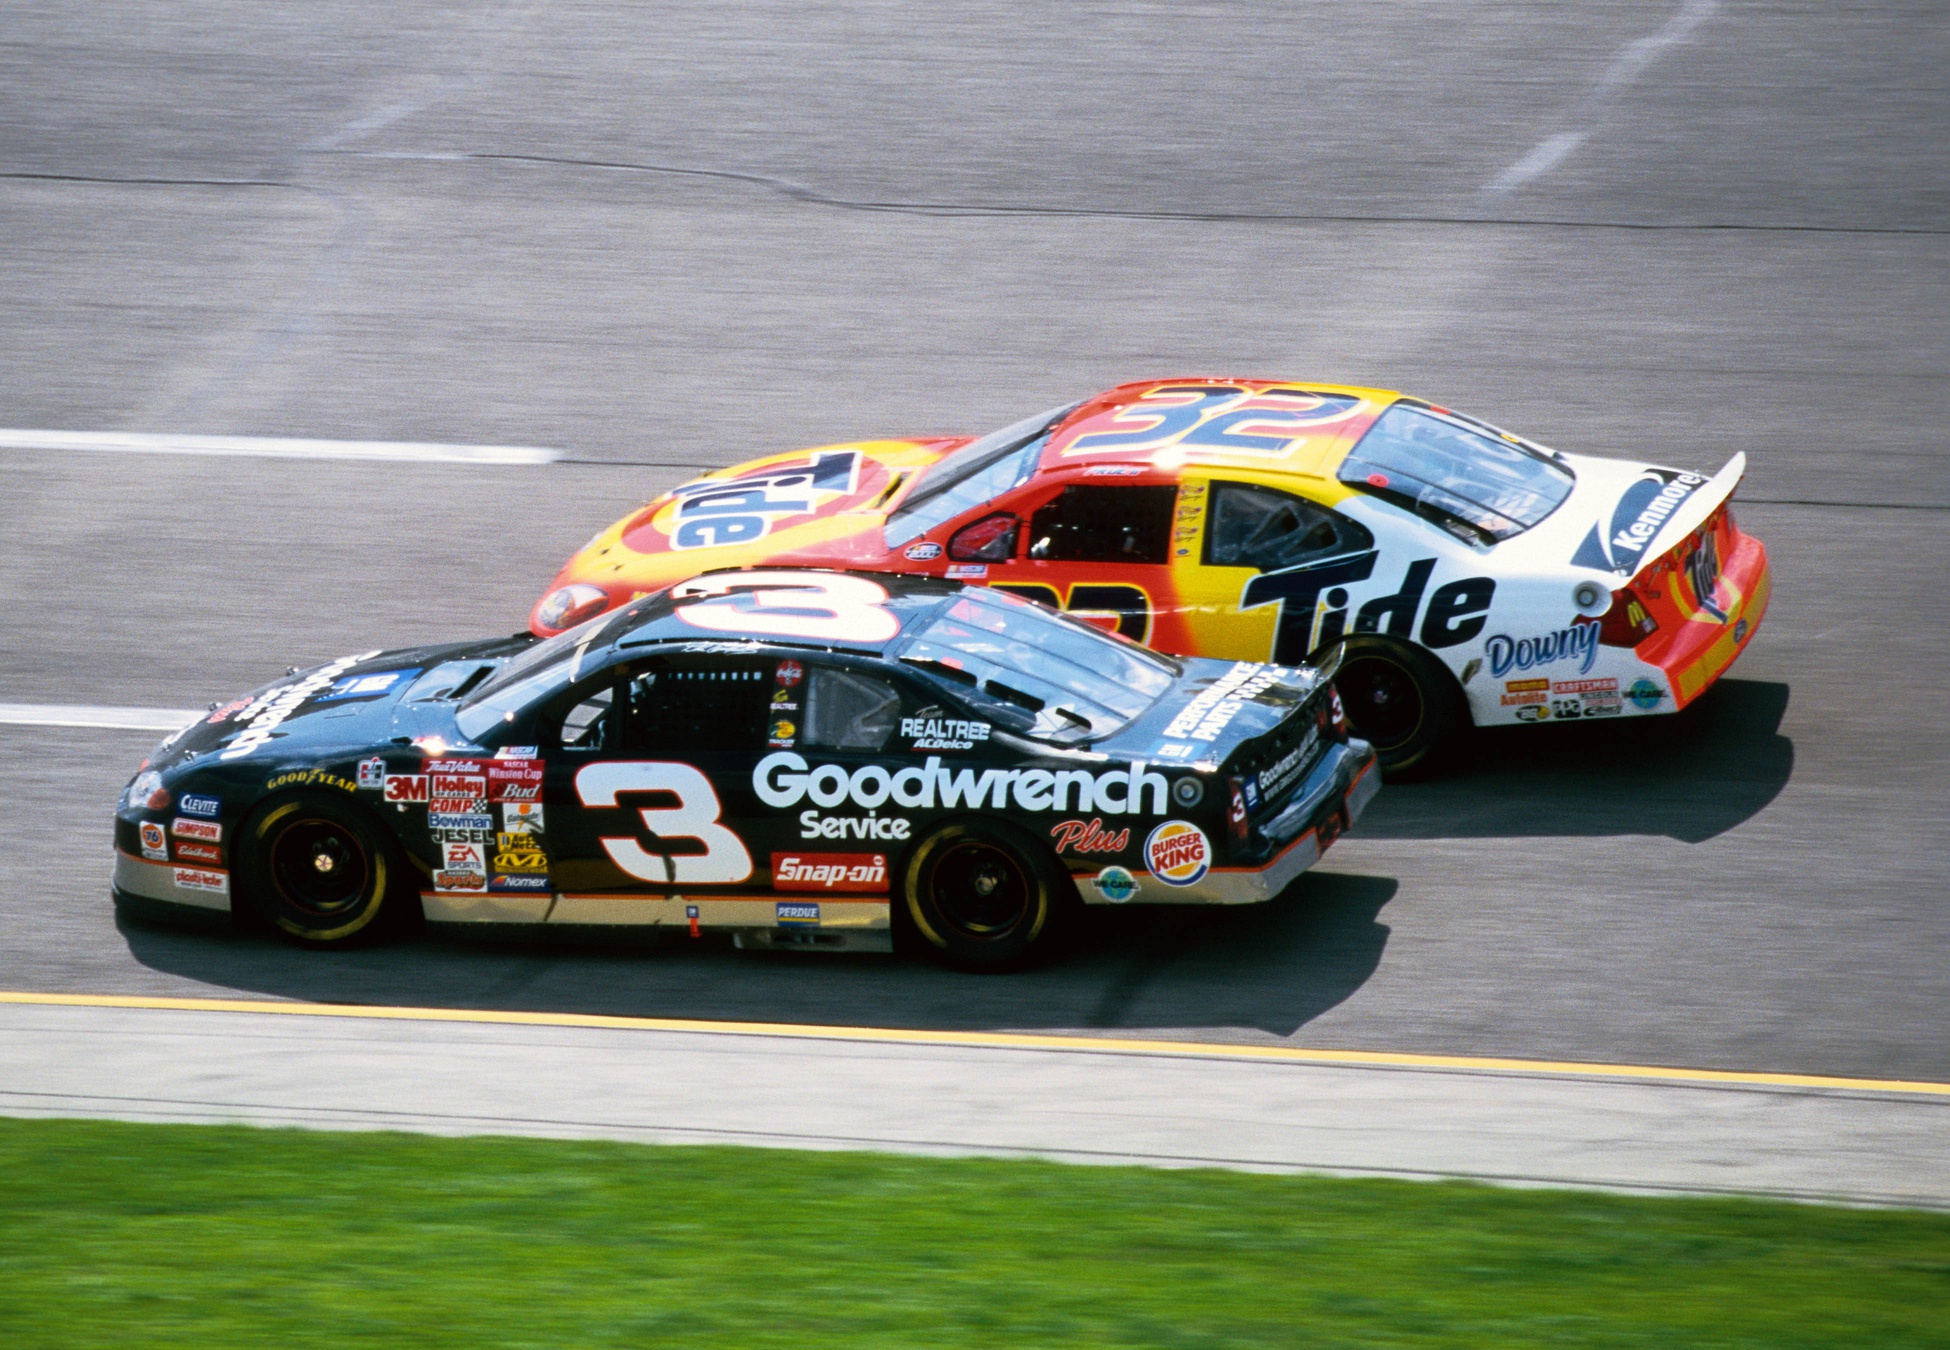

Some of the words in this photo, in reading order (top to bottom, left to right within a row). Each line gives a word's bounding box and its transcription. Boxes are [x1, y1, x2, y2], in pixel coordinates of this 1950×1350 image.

[1061, 384, 1370, 458] 32
[669, 449, 861, 550] Tide
[1612, 474, 1701, 552] Kenmore
[669, 571, 900, 642] 3
[1485, 621, 1601, 677] Downy
[1162, 660, 1261, 740] PERFORMANCE
[1332, 695, 1344, 724] 3
[901, 718, 991, 740] REALTREE
[1190, 701, 1243, 742] PARTS
[913, 738, 973, 749] ACDelco
[386, 777, 427, 800] 3M
[434, 776, 483, 797] Holley
[489, 768, 523, 779] Winston
[524, 769, 542, 780] Cup
[752, 751, 1168, 815] Goodwrench
[429, 799, 473, 812] COMP
[502, 784, 541, 798] Bud
[428, 813, 492, 829] Bowman
[574, 760, 754, 884] 3
[1232, 792, 1246, 823] 3
[146, 830, 159, 842] 76
[176, 822, 217, 838] SIMPSON
[431, 828, 495, 845] JESEL
[800, 810, 911, 840] Service
[1051, 818, 1130, 853] Plus
[1152, 832, 1202, 857] BURGER
[1154, 844, 1204, 874] KING
[504, 877, 547, 887] Nomex
[776, 857, 885, 887] Snap-on
[778, 907, 818, 918] PERDUE
